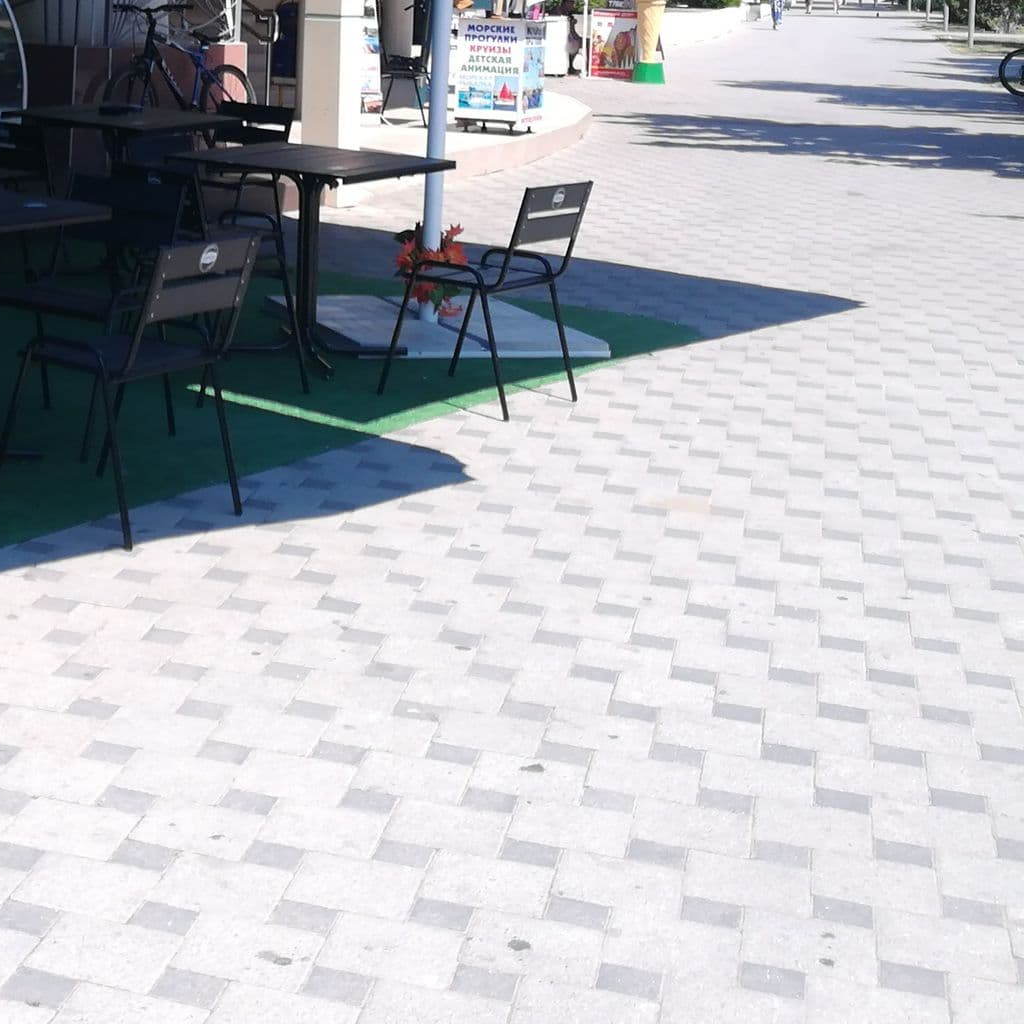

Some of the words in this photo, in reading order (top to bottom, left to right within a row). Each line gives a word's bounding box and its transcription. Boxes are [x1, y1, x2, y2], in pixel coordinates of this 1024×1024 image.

[467, 23, 516, 35] МОРСКИЕ
[464, 33, 518, 44] ПРОГУЛКИ
[469, 44, 512, 55] КРУИЗЫ
[468, 55, 512, 65] ДЕТСКАЯ
[460, 64, 519, 75] АНИМАЦИЯ
